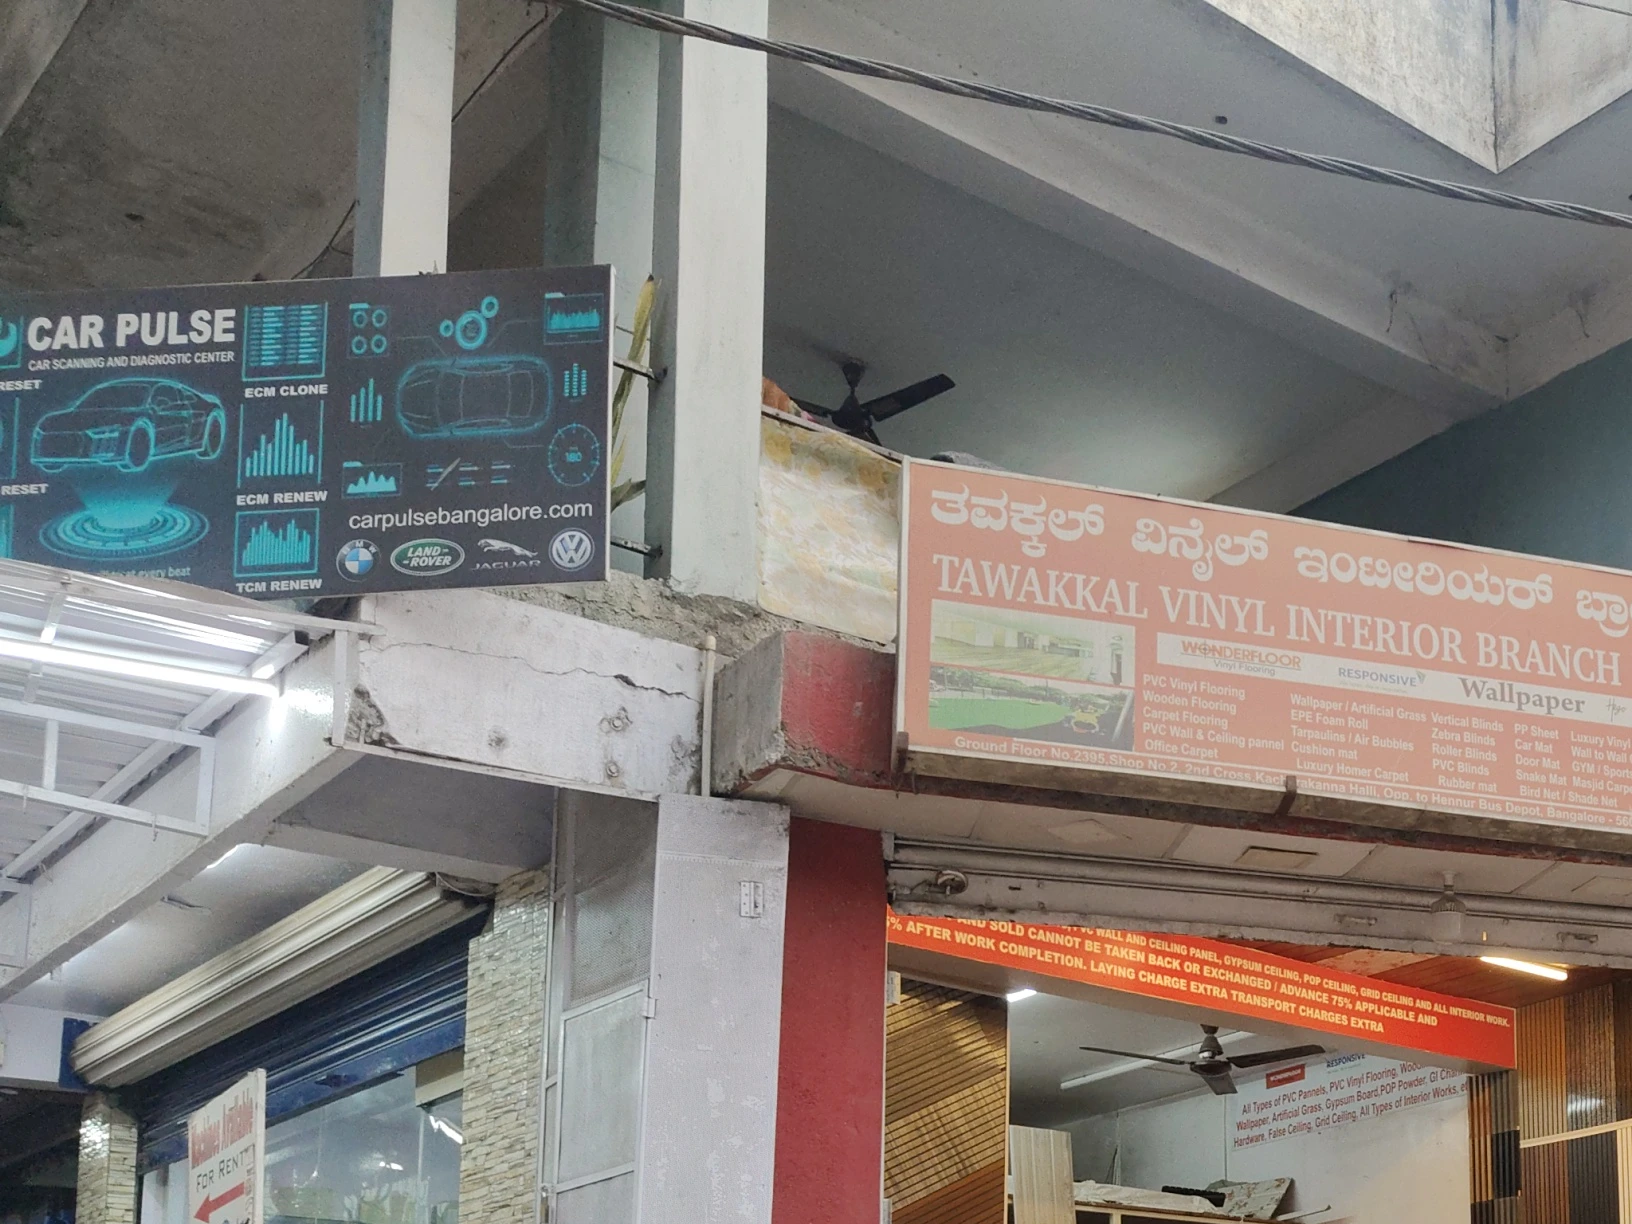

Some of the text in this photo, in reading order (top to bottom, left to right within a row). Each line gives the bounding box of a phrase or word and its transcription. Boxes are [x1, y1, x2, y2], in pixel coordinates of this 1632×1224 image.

[27, 308, 236, 351] CAR PULSE
[28, 351, 235, 371] CAR SCANNING AND DIAGNOSTIC CENTER
[0, 379, 42, 391] RESET
[245, 384, 328, 397] ECM CLONE
[1, 483, 48, 495] RESET
[236, 490, 328, 505] ECM RENEW
[349, 501, 592, 531] carpulsebangalore.com
[473, 559, 541, 569] JAGUAR
[236, 578, 321, 593] TCM RENEW
[932, 553, 1622, 686] TAWAKKAL VINYL INTERIOR BRANCH
[1181, 638, 1301, 669] WONDERFLOOR
[1213, 659, 1275, 677] Vinyl Flooring
[1338, 666, 1416, 687] RESPONSIVE
[1143, 674, 1245, 700] PVC Vinyl Flooring
[1458, 676, 1585, 716] Wallpaper
[1143, 690, 1236, 714] Wooden Flooring
[1143, 706, 1228, 729] Carpet Flooring
[1291, 709, 1368, 729] EPE Foam Roll
[1431, 712, 1503, 731] Vertical Blinds
[1431, 728, 1495, 746] Zebra Blinds
[1514, 723, 1558, 739] PP Sheet
[1432, 743, 1497, 761] Roller Blinds
[1515, 739, 1552, 753] Car Mat
[1432, 759, 1489, 776] PVC Blinds
[1515, 754, 1560, 770] Door Mat
[1516, 769, 1567, 785] Snake Mat
[906, 920, 1383, 1033] AFTER WORK COMPLETION. LAYING CHARGE EXTRA TRANSPORT CHARGES EXTRA
[989, 919, 1023, 936] SOLD
[1028, 927, 1080, 949] CANNOT
[1084, 939, 1100, 953] BE
[1104, 943, 1144, 963] TAKEN
[1148, 953, 1180, 970] BACK
[1184, 961, 1199, 974] OR
[1204, 965, 1271, 990] EXCHANGED
[1279, 982, 1328, 1003] ADVANCE
[1331, 995, 1352, 1009] 75%
[1355, 1000, 1414, 1022] APPLICABLE
[1417, 1013, 1437, 1026] AND
[1125, 933, 1146, 946] AND
[1149, 938, 1187, 955] CEILING
[1189, 947, 1221, 965] PANEL,
[1224, 955, 1261, 972] GYPSUM
[1264, 964, 1301, 983] CEILING,
[1303, 973, 1320, 986] POP
[1323, 978, 1358, 996] CEILING,
[1360, 987, 1379, 999] GRID
[1382, 991, 1413, 1006] CEILING
[1415, 998, 1431, 1010] AND
[1433, 1002, 1447, 1014] ALL
[1449, 1006, 1484, 1022] INTERIOR
[1486, 1014, 1509, 1027] WORK.
[1242, 1104, 1251, 1115] All
[1252, 1101, 1272, 1114] Types
[1282, 1093, 1297, 1104] PVC
[1330, 1081, 1344, 1093] PVC
[1346, 1075, 1364, 1090] Vinyl
[1366, 1066, 1398, 1083] Flooring,
[196, 1169, 215, 1192] FOR
